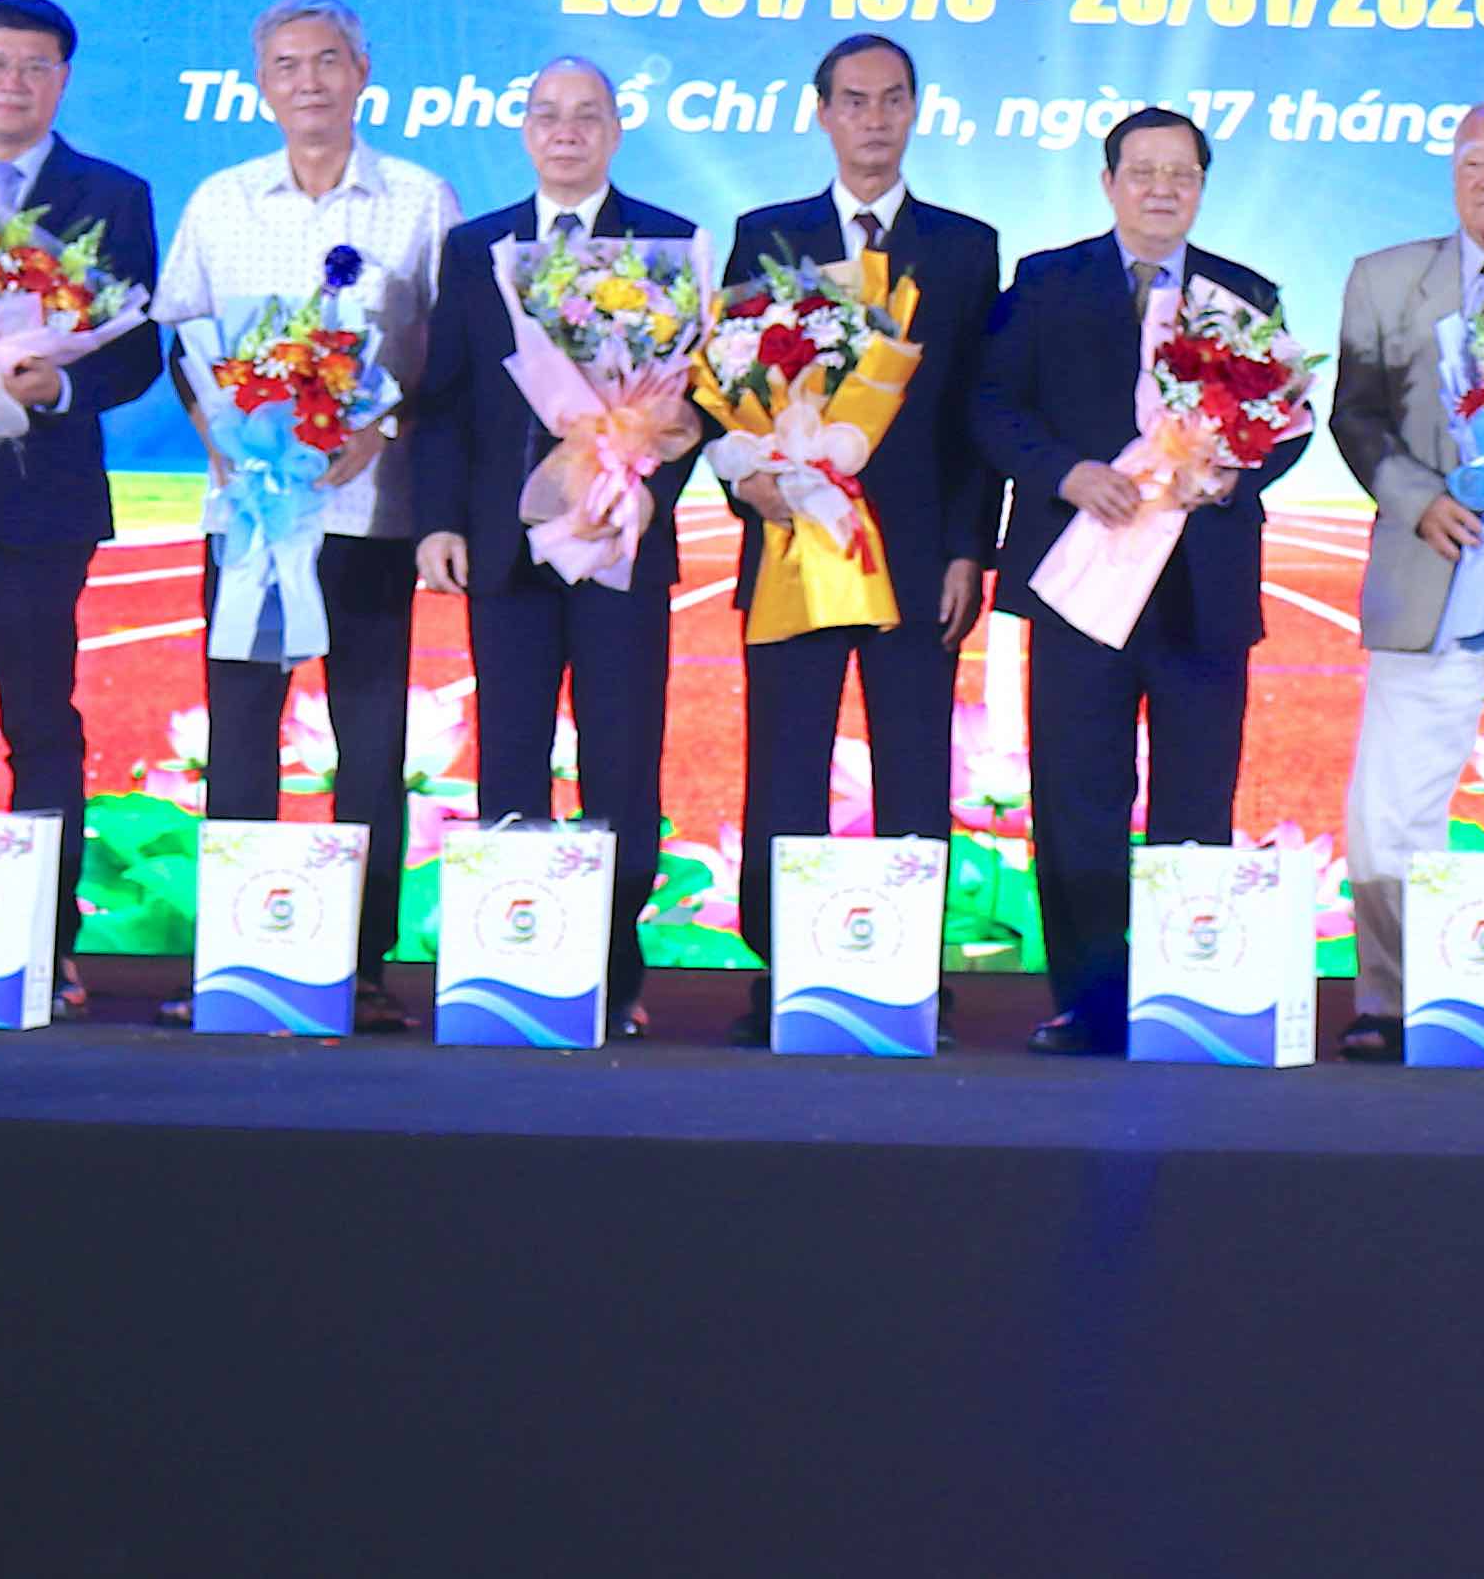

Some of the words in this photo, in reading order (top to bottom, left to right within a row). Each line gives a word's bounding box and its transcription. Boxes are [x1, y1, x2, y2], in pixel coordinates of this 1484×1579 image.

[179, 68, 390, 126] Thh
[667, 79, 787, 133] Chí
[995, 83, 1173, 151] ngà
[1187, 89, 1256, 142] 17
[1267, 89, 1471, 157] tháng
